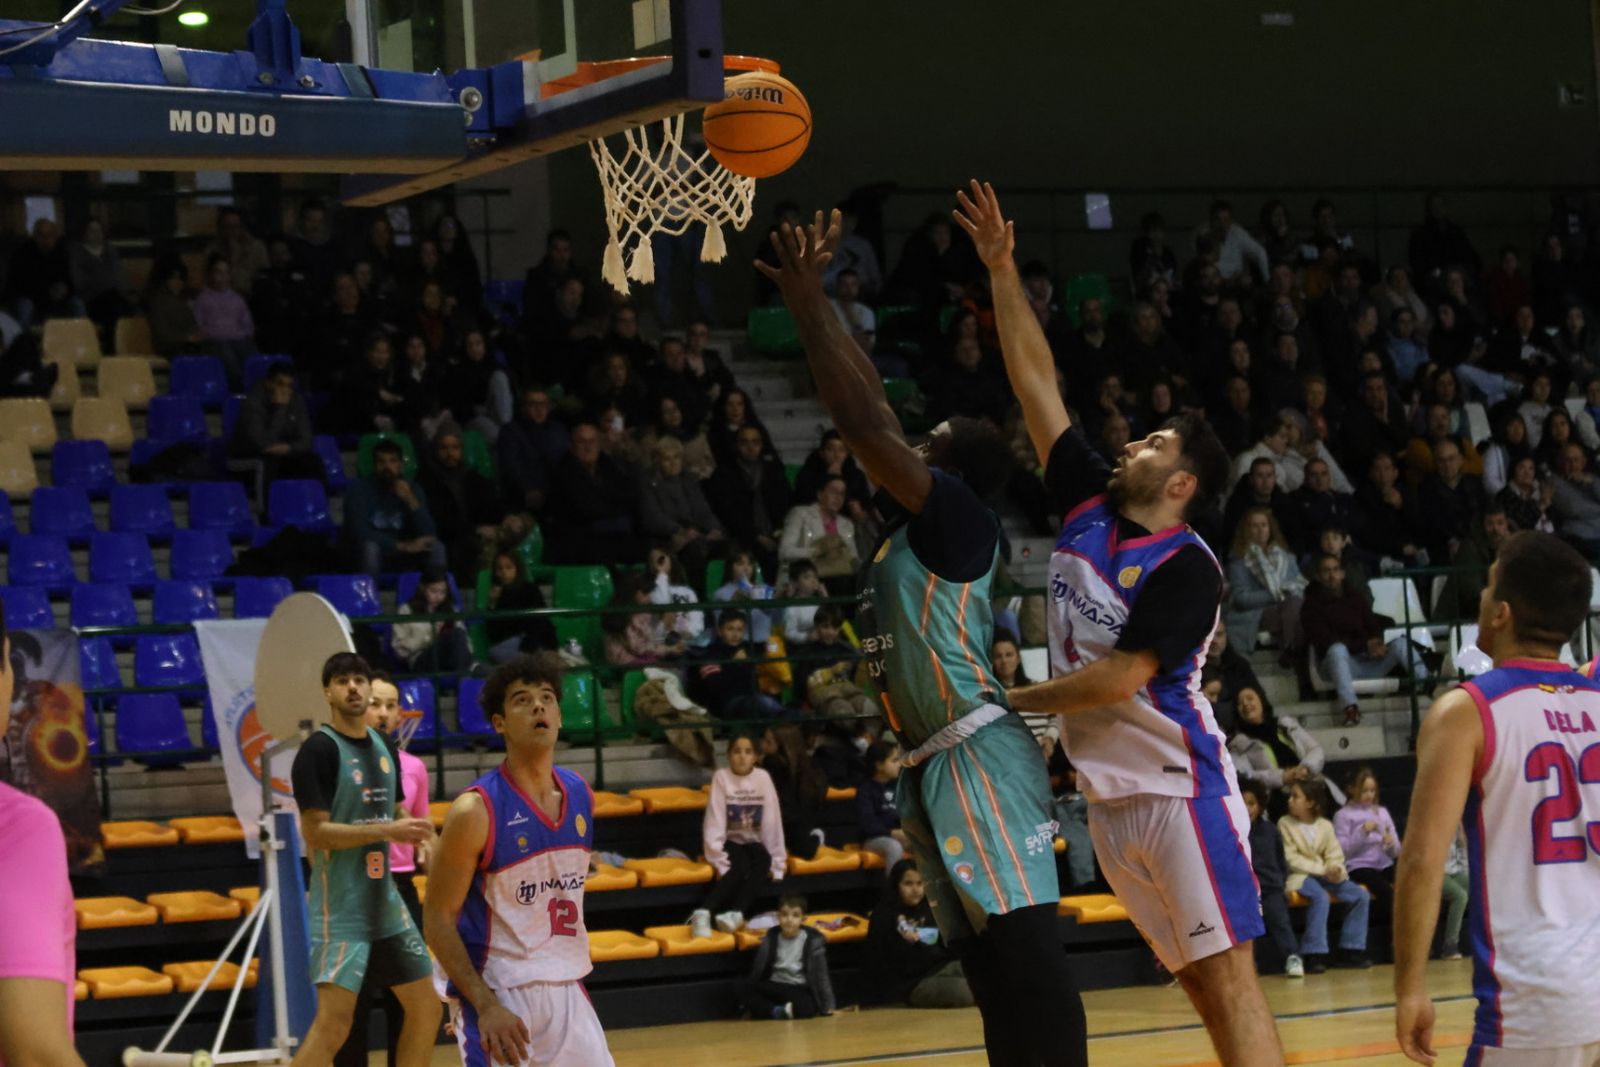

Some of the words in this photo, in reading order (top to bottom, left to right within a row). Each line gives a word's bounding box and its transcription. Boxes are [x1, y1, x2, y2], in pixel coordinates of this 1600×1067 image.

[169, 109, 276, 137] MONDO
[366, 851, 385, 879] 8
[547, 898, 579, 937] 12
